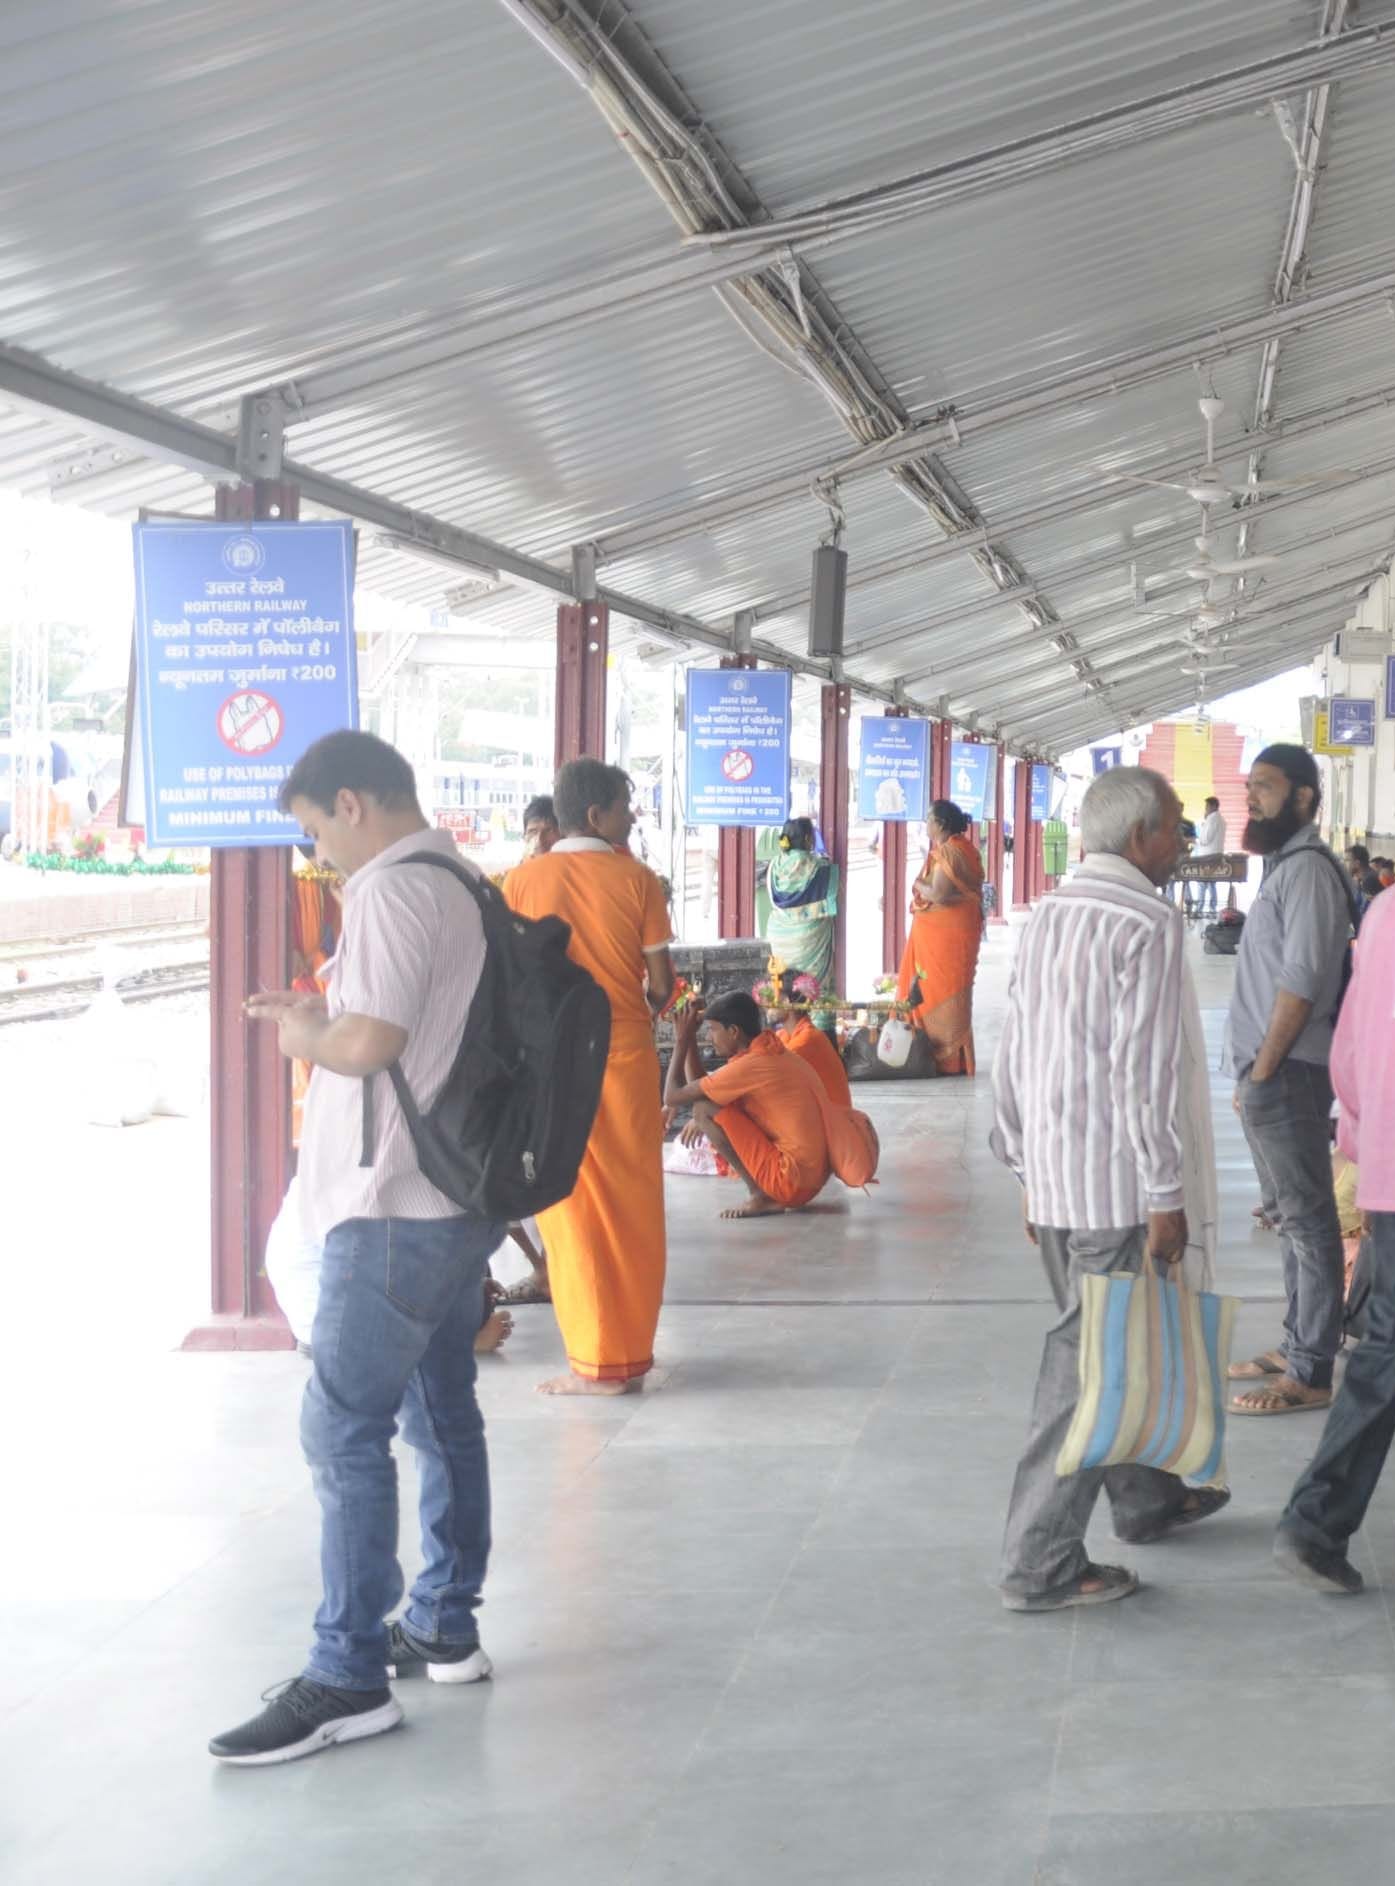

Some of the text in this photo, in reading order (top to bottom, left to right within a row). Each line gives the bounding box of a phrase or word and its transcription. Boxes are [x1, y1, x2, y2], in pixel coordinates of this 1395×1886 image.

[205, 577, 285, 595] उत्तर रेलवे
[184, 600, 308, 613] NORTHERN RAILWAY
[152, 620, 191, 637] रेलवे
[183, 767, 208, 782] USE
[209, 767, 223, 781] OF
[226, 766, 285, 781] POLYBAGS
[160, 787, 208, 801] RAILWAY
[212, 785, 266, 801] PREMISES
[168, 810, 250, 826] MINIMUM
